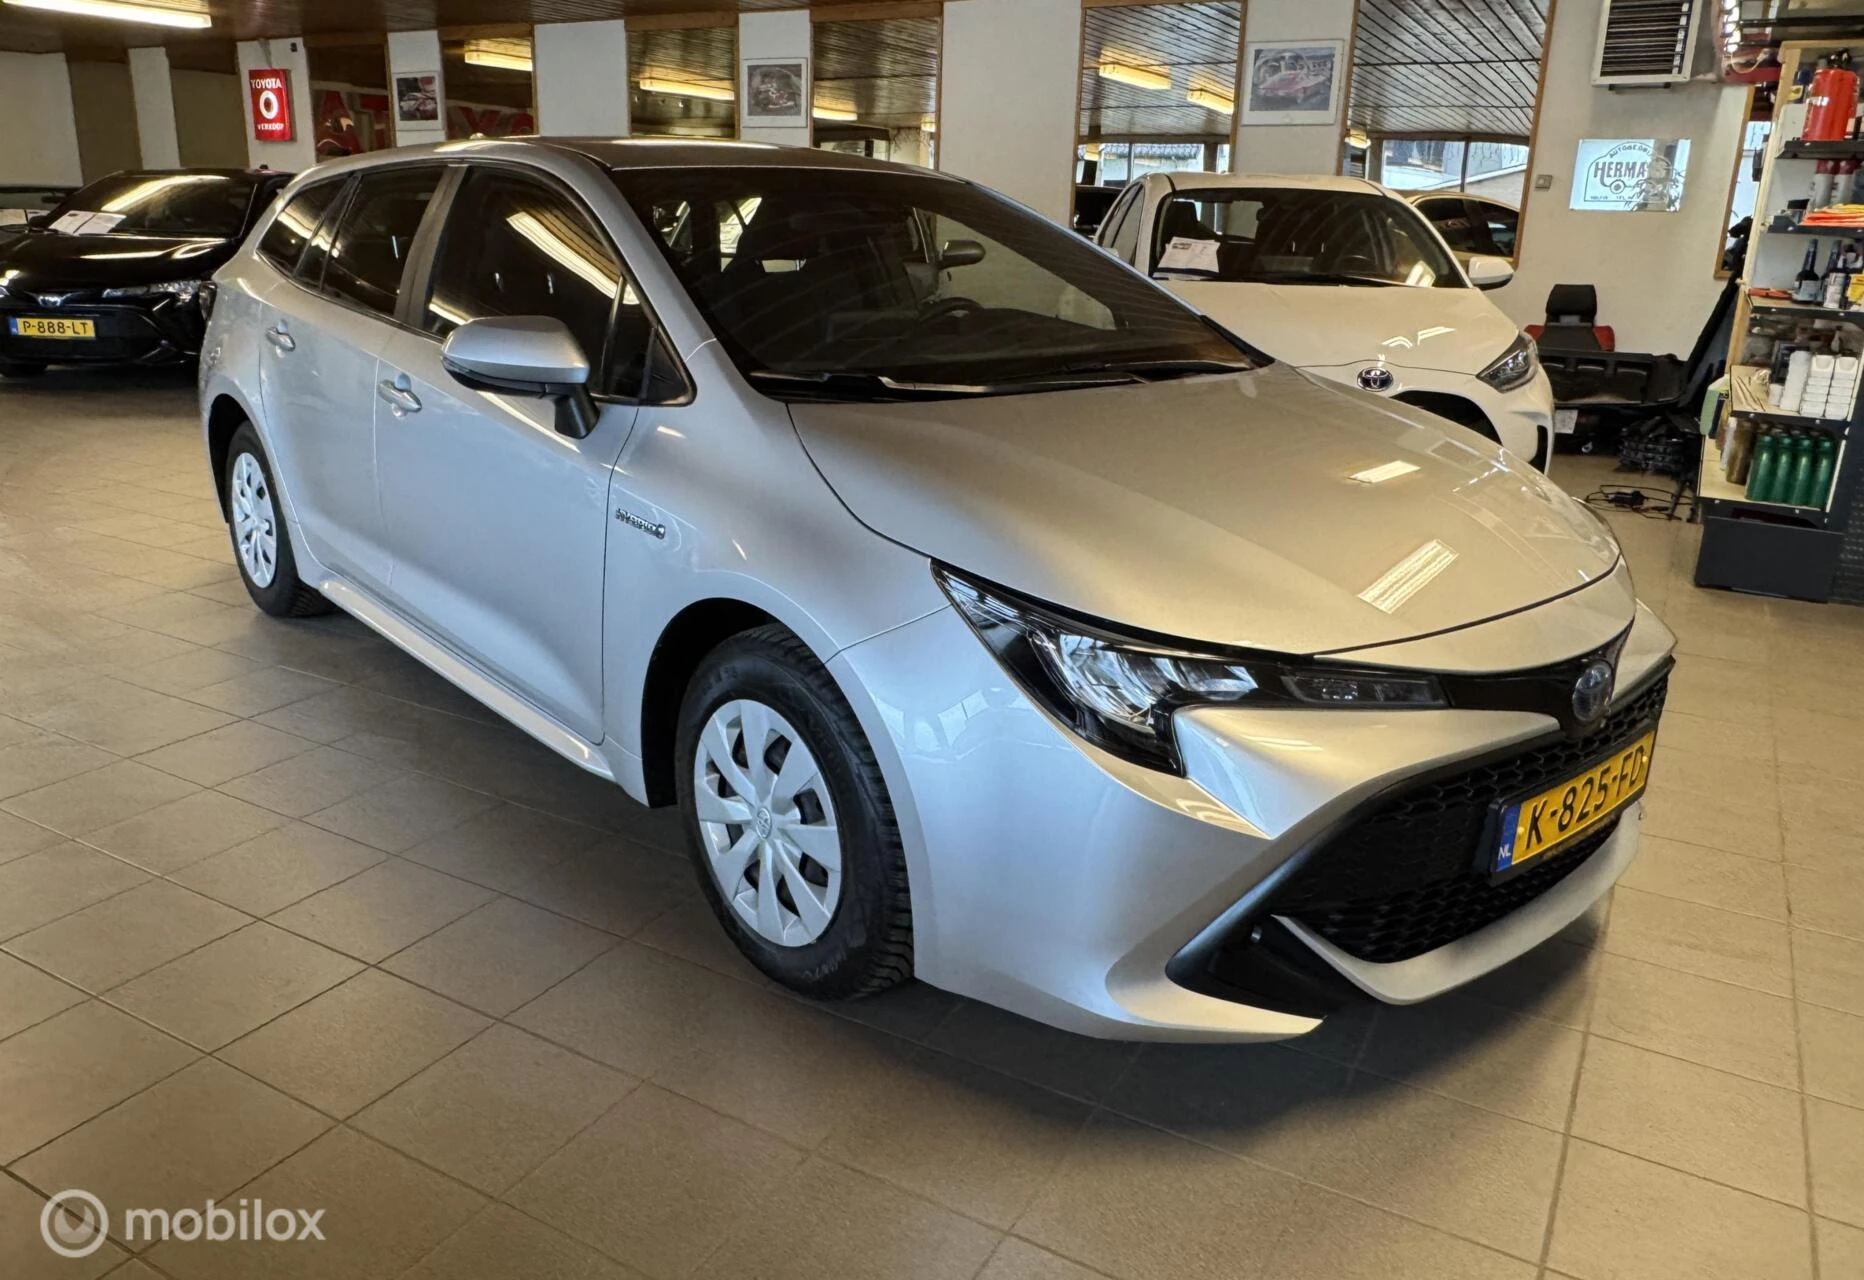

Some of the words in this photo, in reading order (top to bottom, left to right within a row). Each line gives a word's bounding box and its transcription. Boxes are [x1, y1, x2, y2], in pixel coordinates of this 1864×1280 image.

[251, 79, 282, 89] TOYOTA
[23, 321, 89, 335] P-888-LT
[1525, 744, 1645, 851] K-825-FD
[1497, 847, 1512, 861] NL
